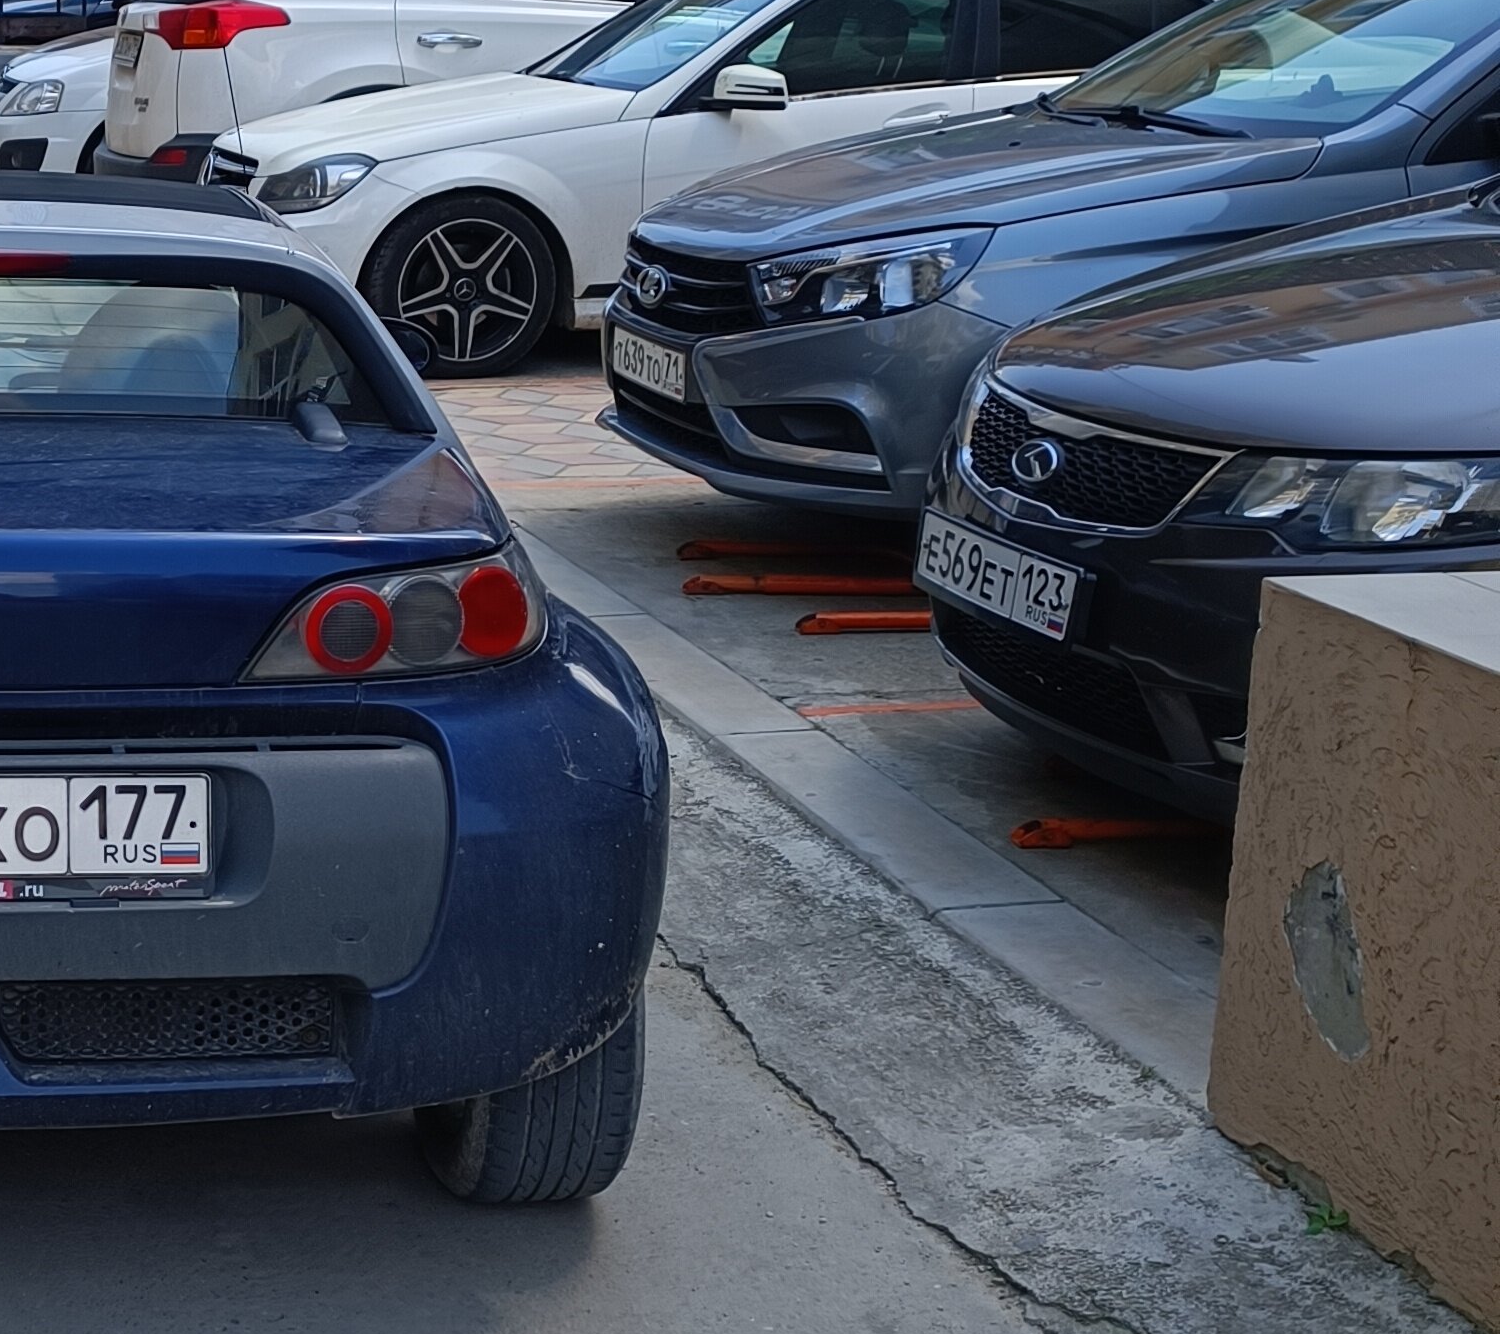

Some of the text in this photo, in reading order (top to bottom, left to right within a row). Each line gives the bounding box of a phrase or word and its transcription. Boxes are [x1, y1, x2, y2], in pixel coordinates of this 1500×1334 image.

[615, 338, 679, 385] Т639ТО 71
[925, 529, 1066, 612] Е569ЕТ 123
[1025, 604, 1048, 627] RUS
[79, 784, 187, 840] 177
[103, 843, 157, 864] RUS
